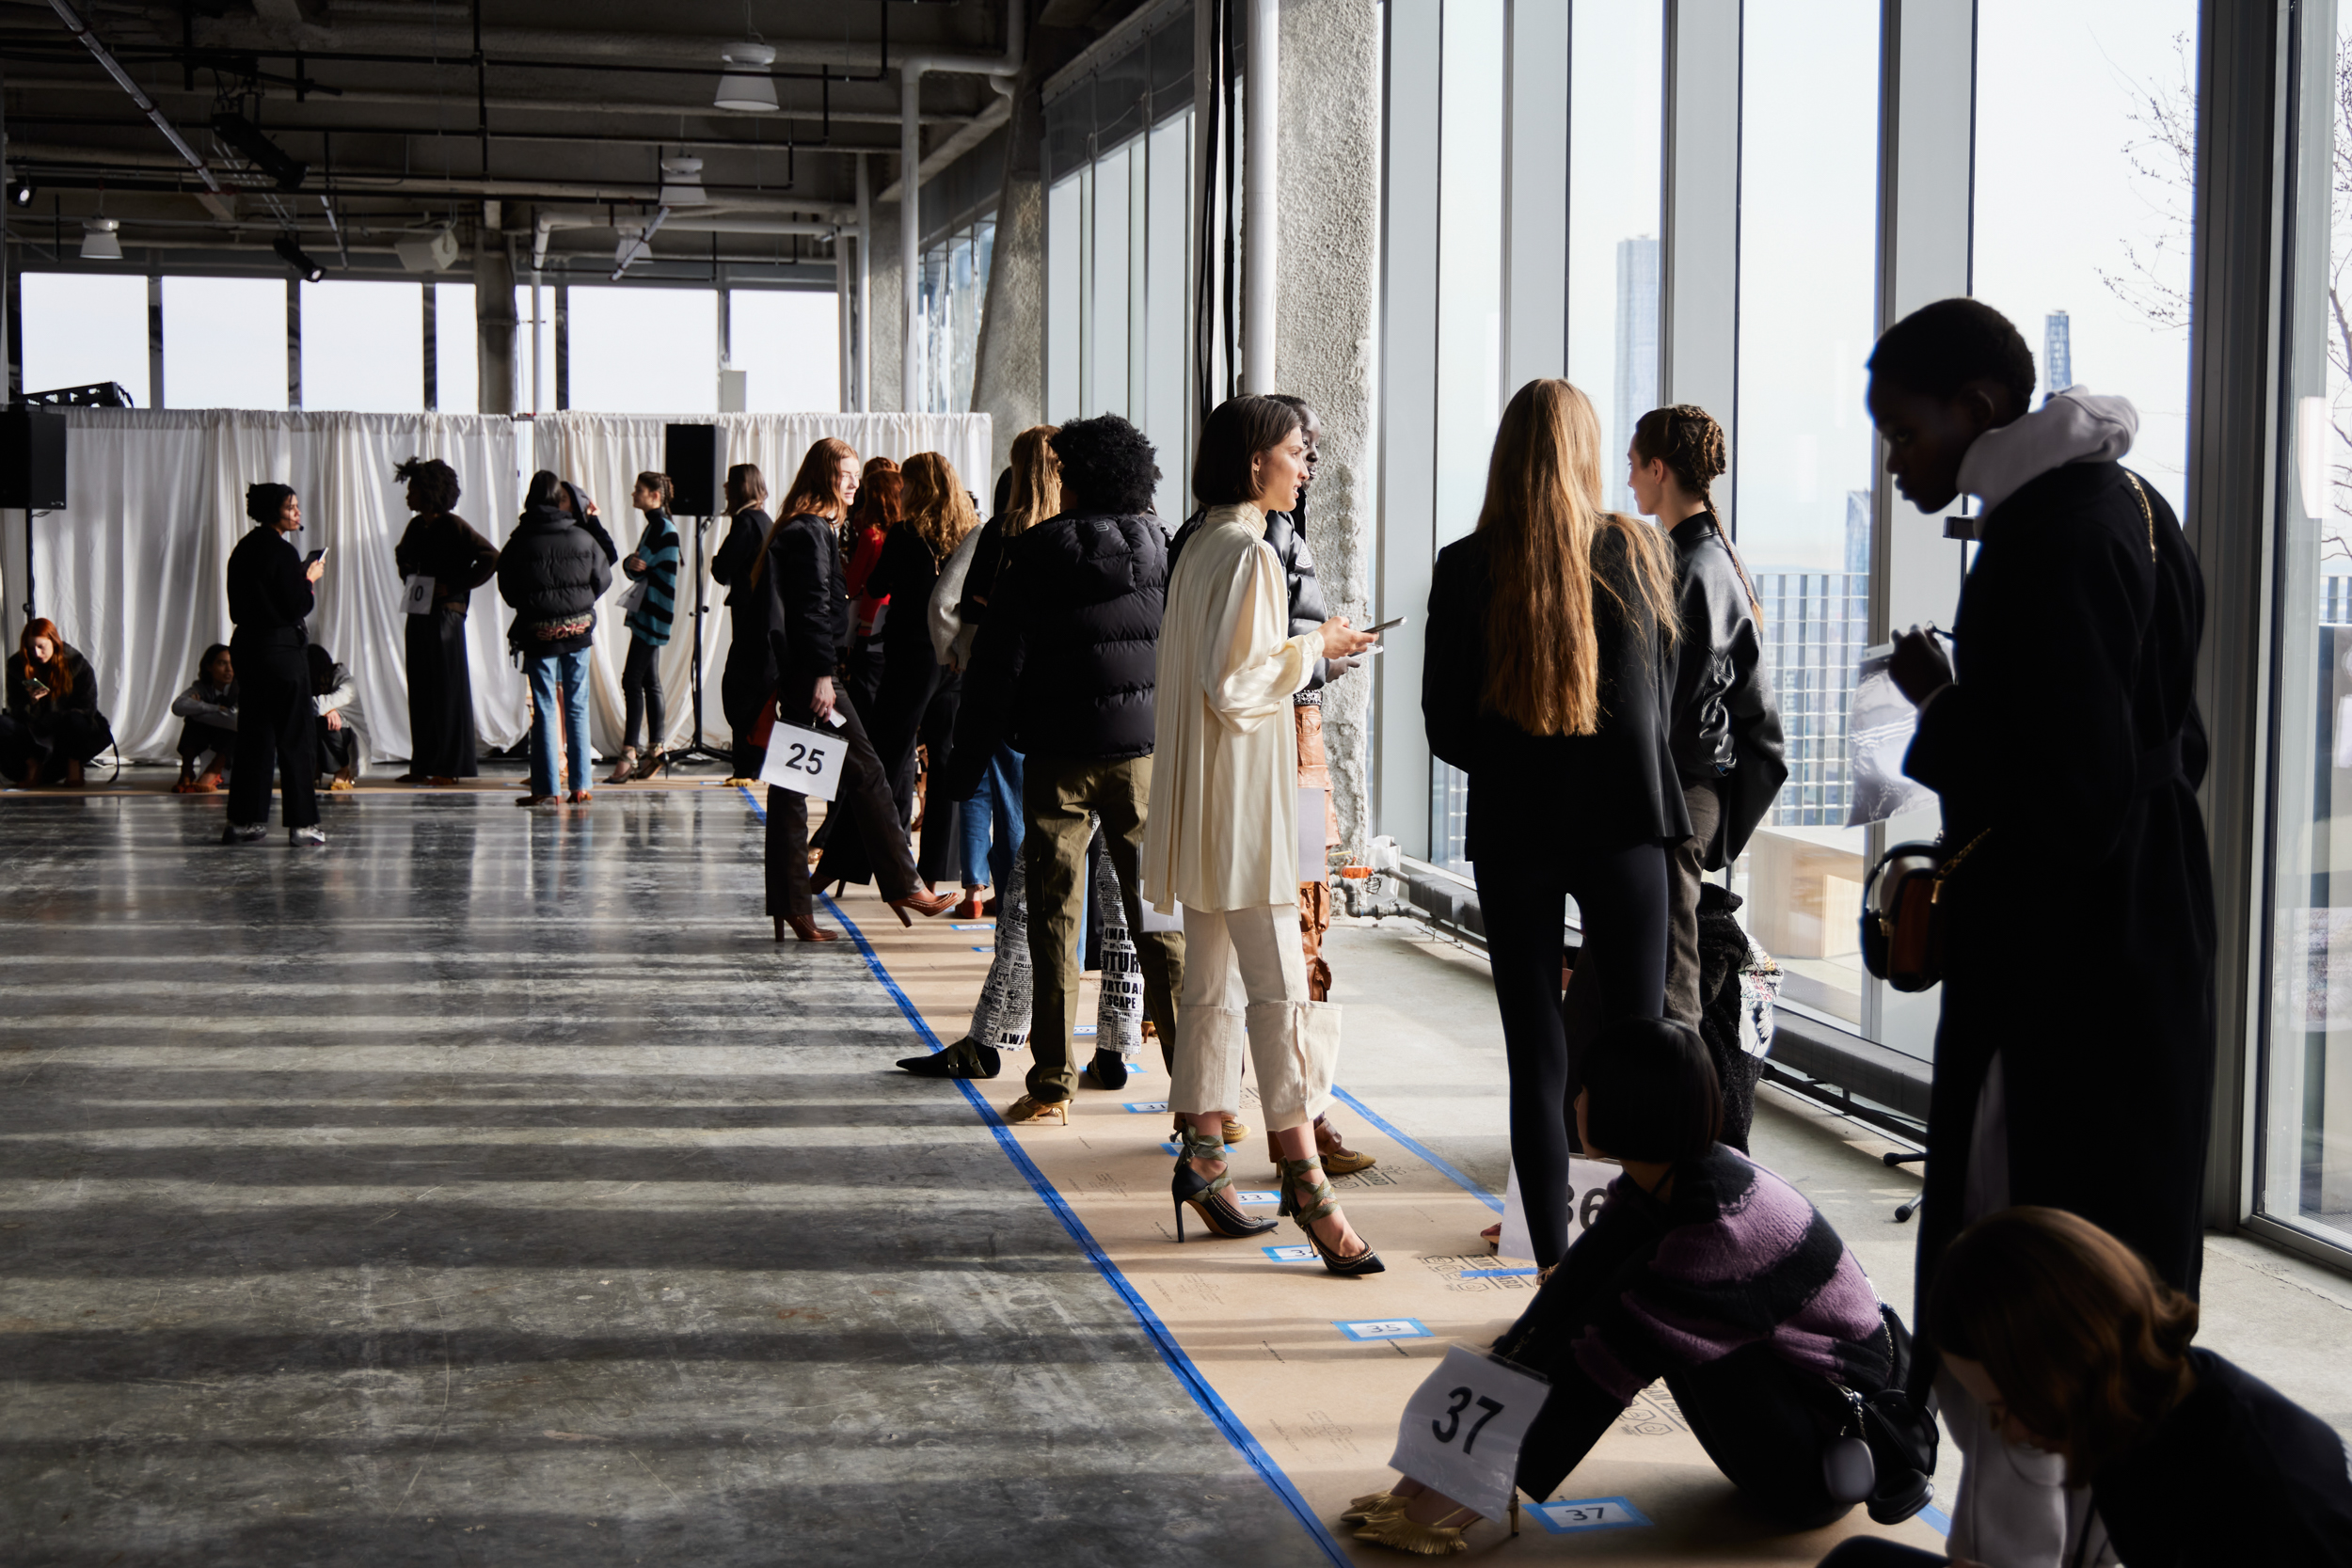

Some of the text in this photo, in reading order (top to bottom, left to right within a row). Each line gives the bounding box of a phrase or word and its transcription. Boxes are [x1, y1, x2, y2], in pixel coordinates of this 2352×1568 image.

[785, 742, 825, 775] 25
[1366, 1323, 1402, 1334] 35
[1432, 1386, 1505, 1456] 37
[1565, 1507, 1604, 1521] 37
